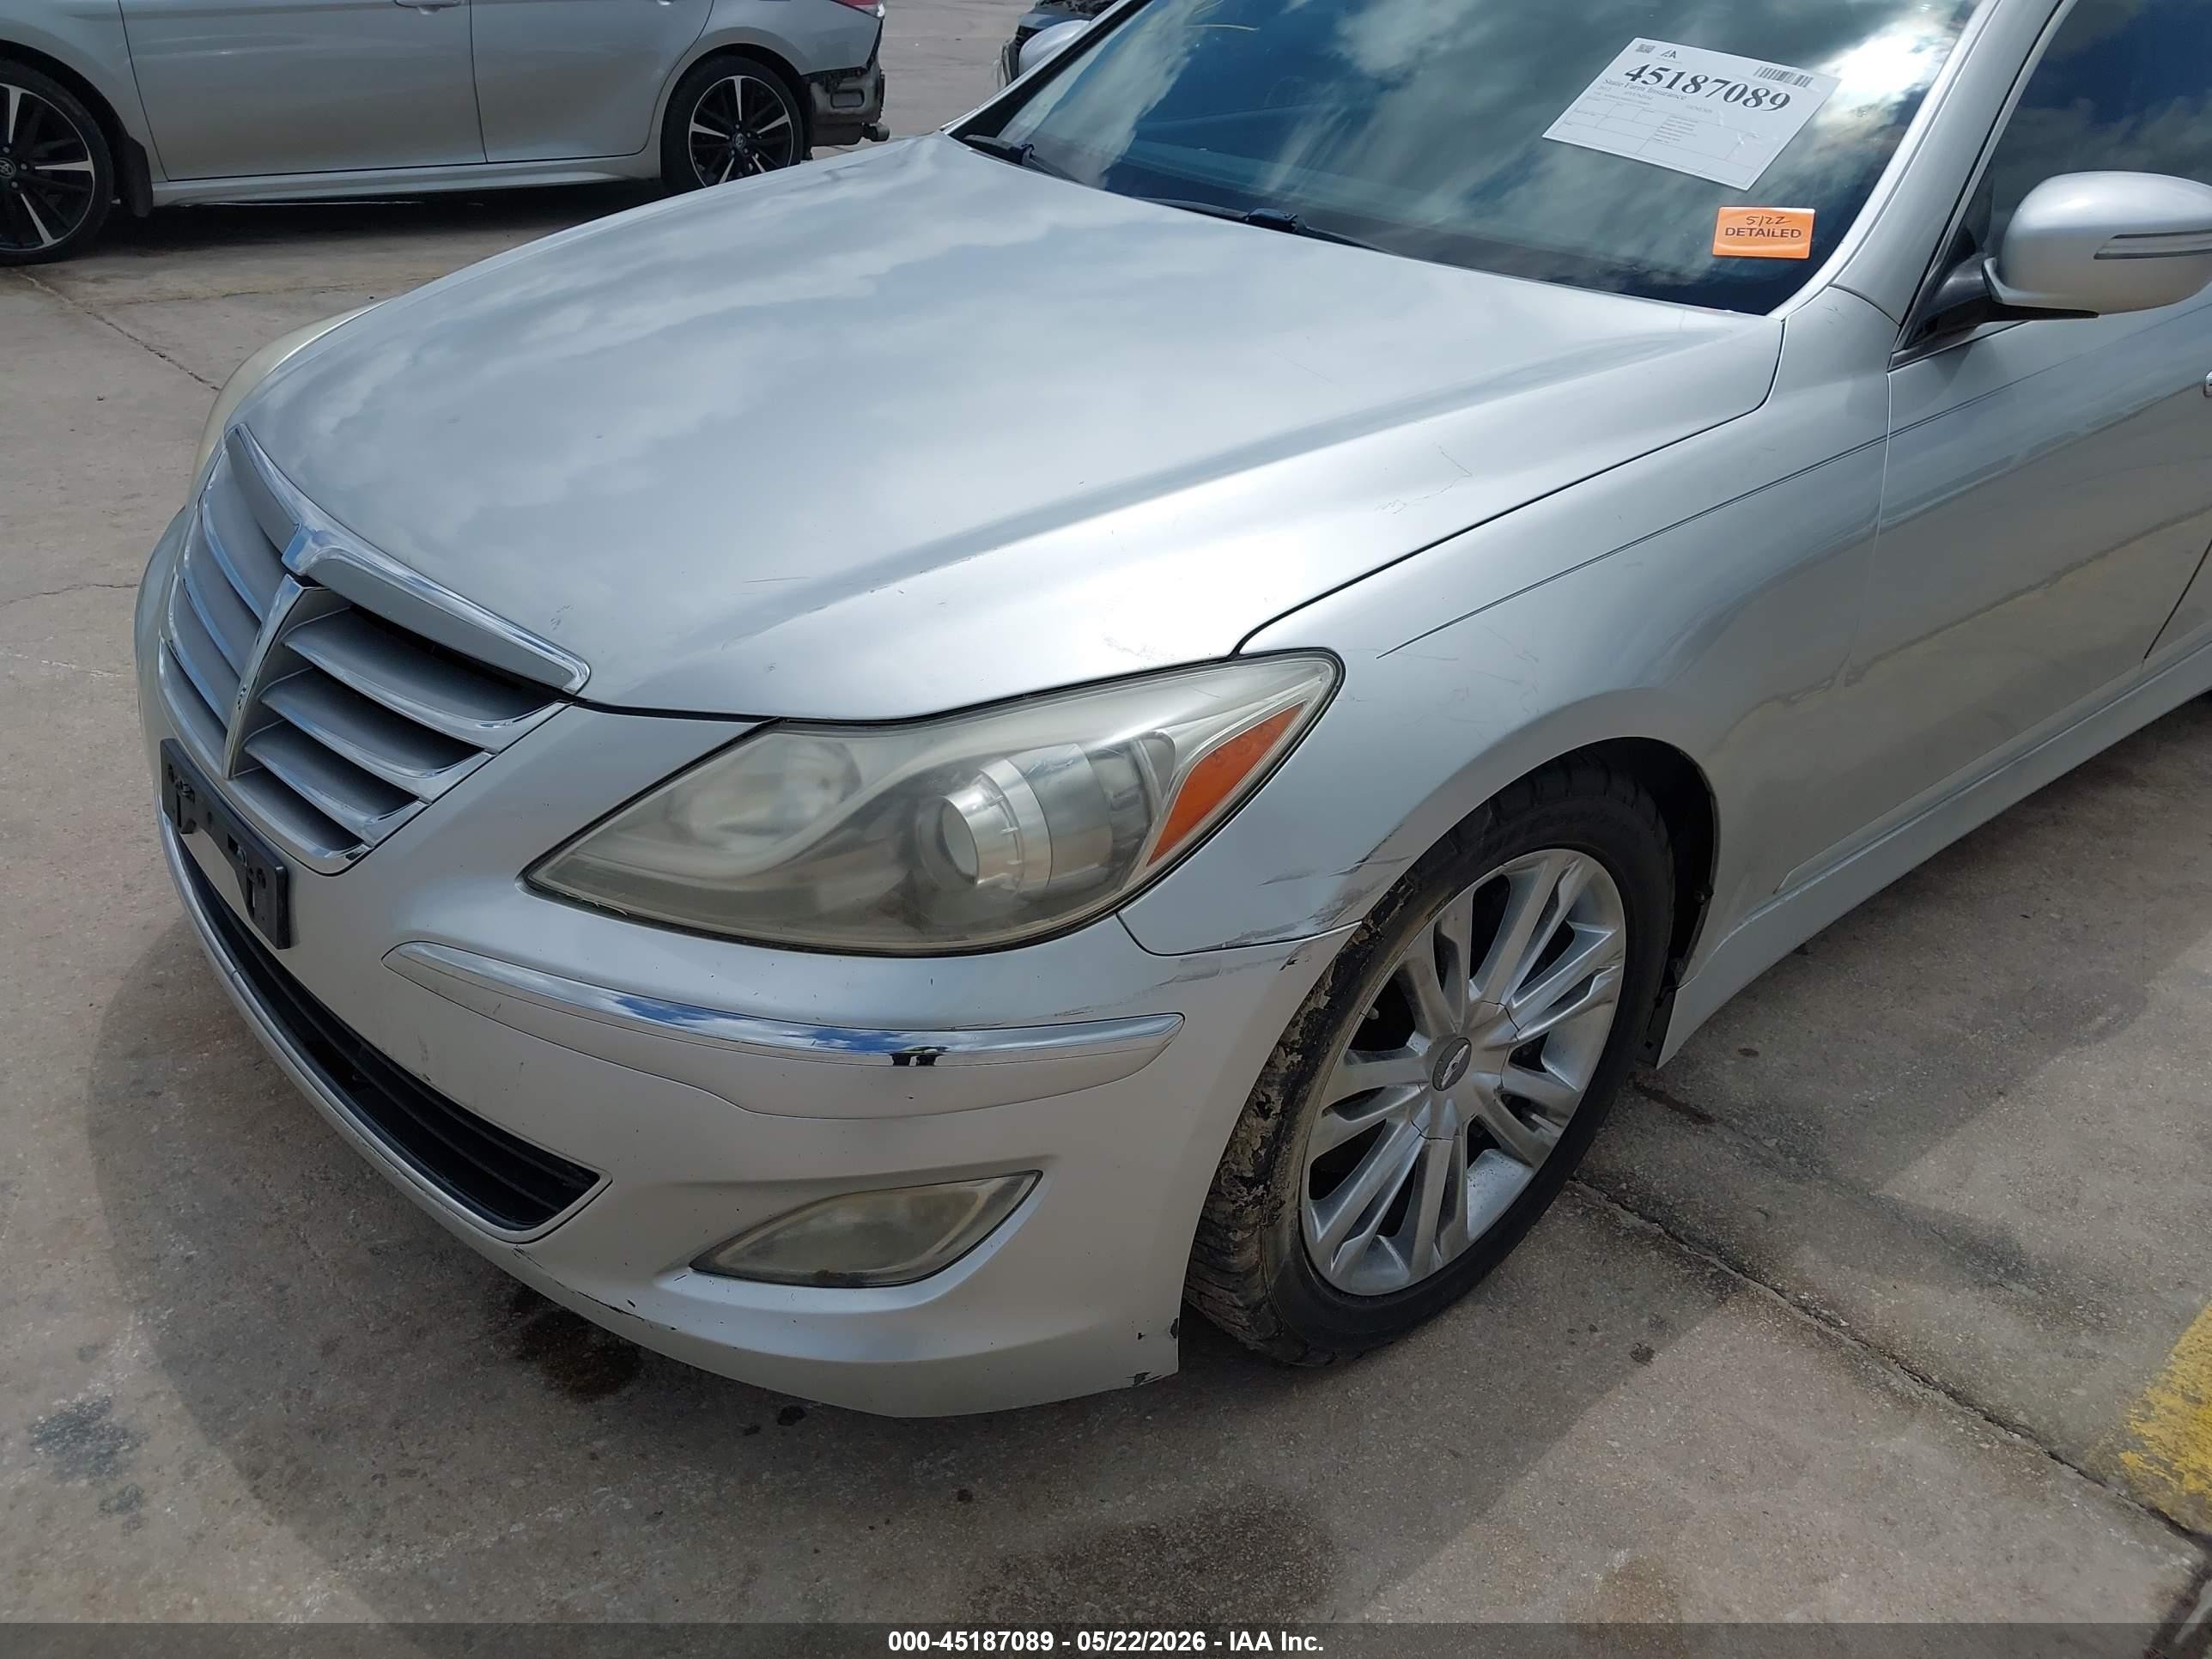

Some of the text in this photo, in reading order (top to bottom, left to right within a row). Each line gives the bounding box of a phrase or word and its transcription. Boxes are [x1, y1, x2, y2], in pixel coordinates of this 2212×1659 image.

[1624, 82, 1647, 91] Farm
[1646, 88, 1687, 100] Insurance
[1625, 64, 1790, 112] 45187089
[1725, 227, 1802, 239] DETAILED
